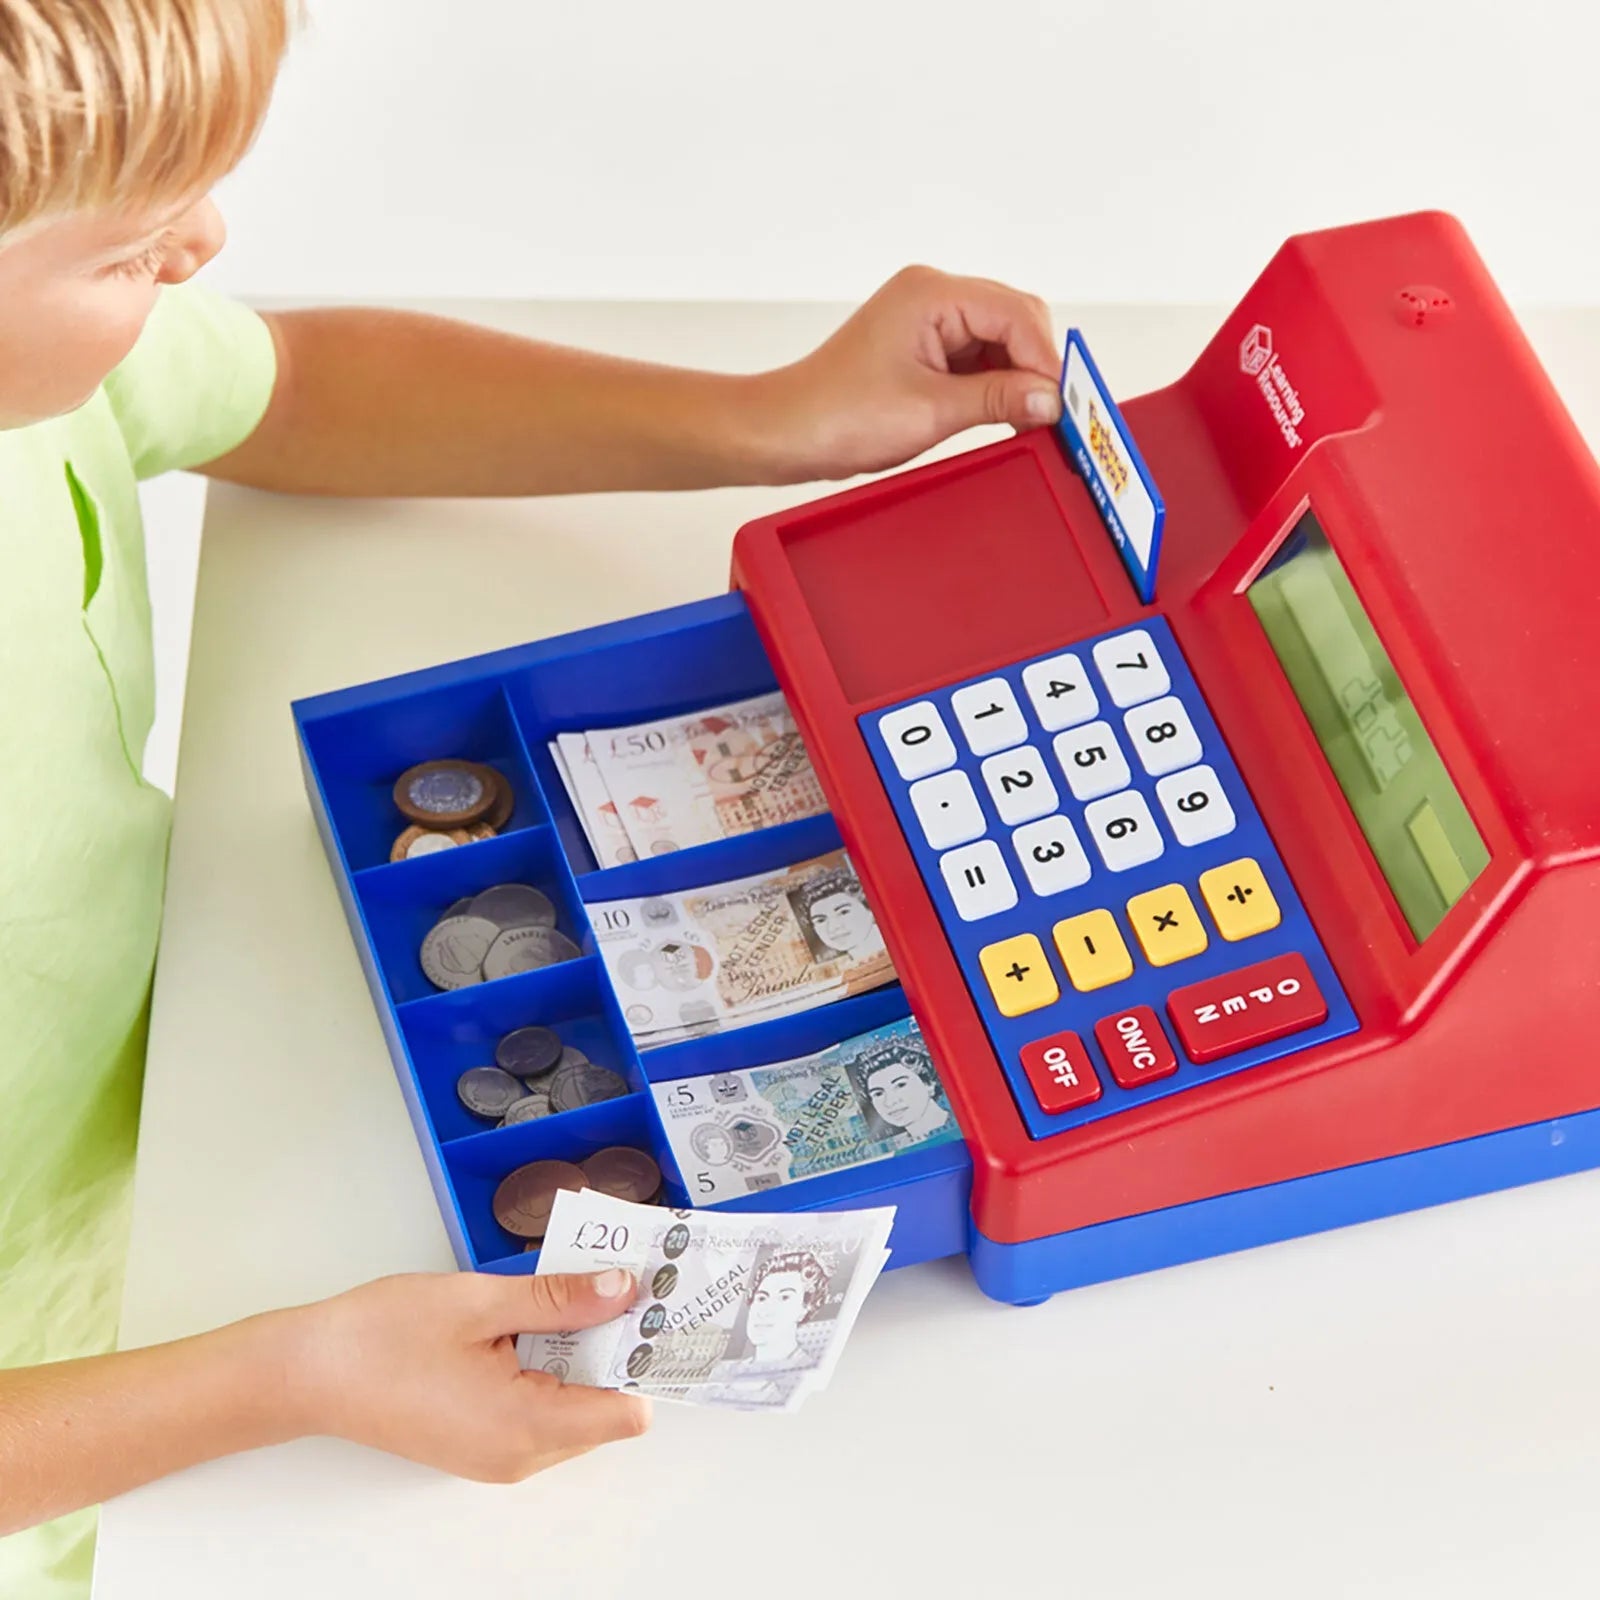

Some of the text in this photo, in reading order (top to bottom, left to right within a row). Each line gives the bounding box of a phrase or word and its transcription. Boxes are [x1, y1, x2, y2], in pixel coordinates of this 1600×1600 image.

[1268, 352, 1305, 426] Learning
[1116, 652, 1149, 670] 7
[1046, 680, 1076, 698] 4
[973, 703, 1004, 719] 1
[901, 726, 932, 745] 0
[1145, 722, 1177, 743] 8
[610, 731, 667, 759] £50
[1074, 746, 1107, 767] 5
[1000, 770, 1034, 793] 2
[1177, 791, 1209, 812] 9
[1106, 817, 1138, 838] 6
[1033, 841, 1065, 863] 3
[721, 943, 747, 969] NOT
[742, 903, 780, 943] LEGAL
[744, 915, 789, 968] TENDER
[1194, 978, 1301, 1024] OPEN
[1116, 1016, 1156, 1069] ON/C
[1043, 1047, 1079, 1088] OFF
[667, 1084, 695, 1107] £5
[782, 1075, 841, 1147] NOT LEGAL
[805, 1090, 851, 1144] TENDER
[697, 1171, 716, 1193] 5
[570, 1220, 629, 1251] £20
[660, 1264, 750, 1334] NOT LEGAL
[679, 1281, 746, 1337] TENDER
[642, 1310, 665, 1329] 20
